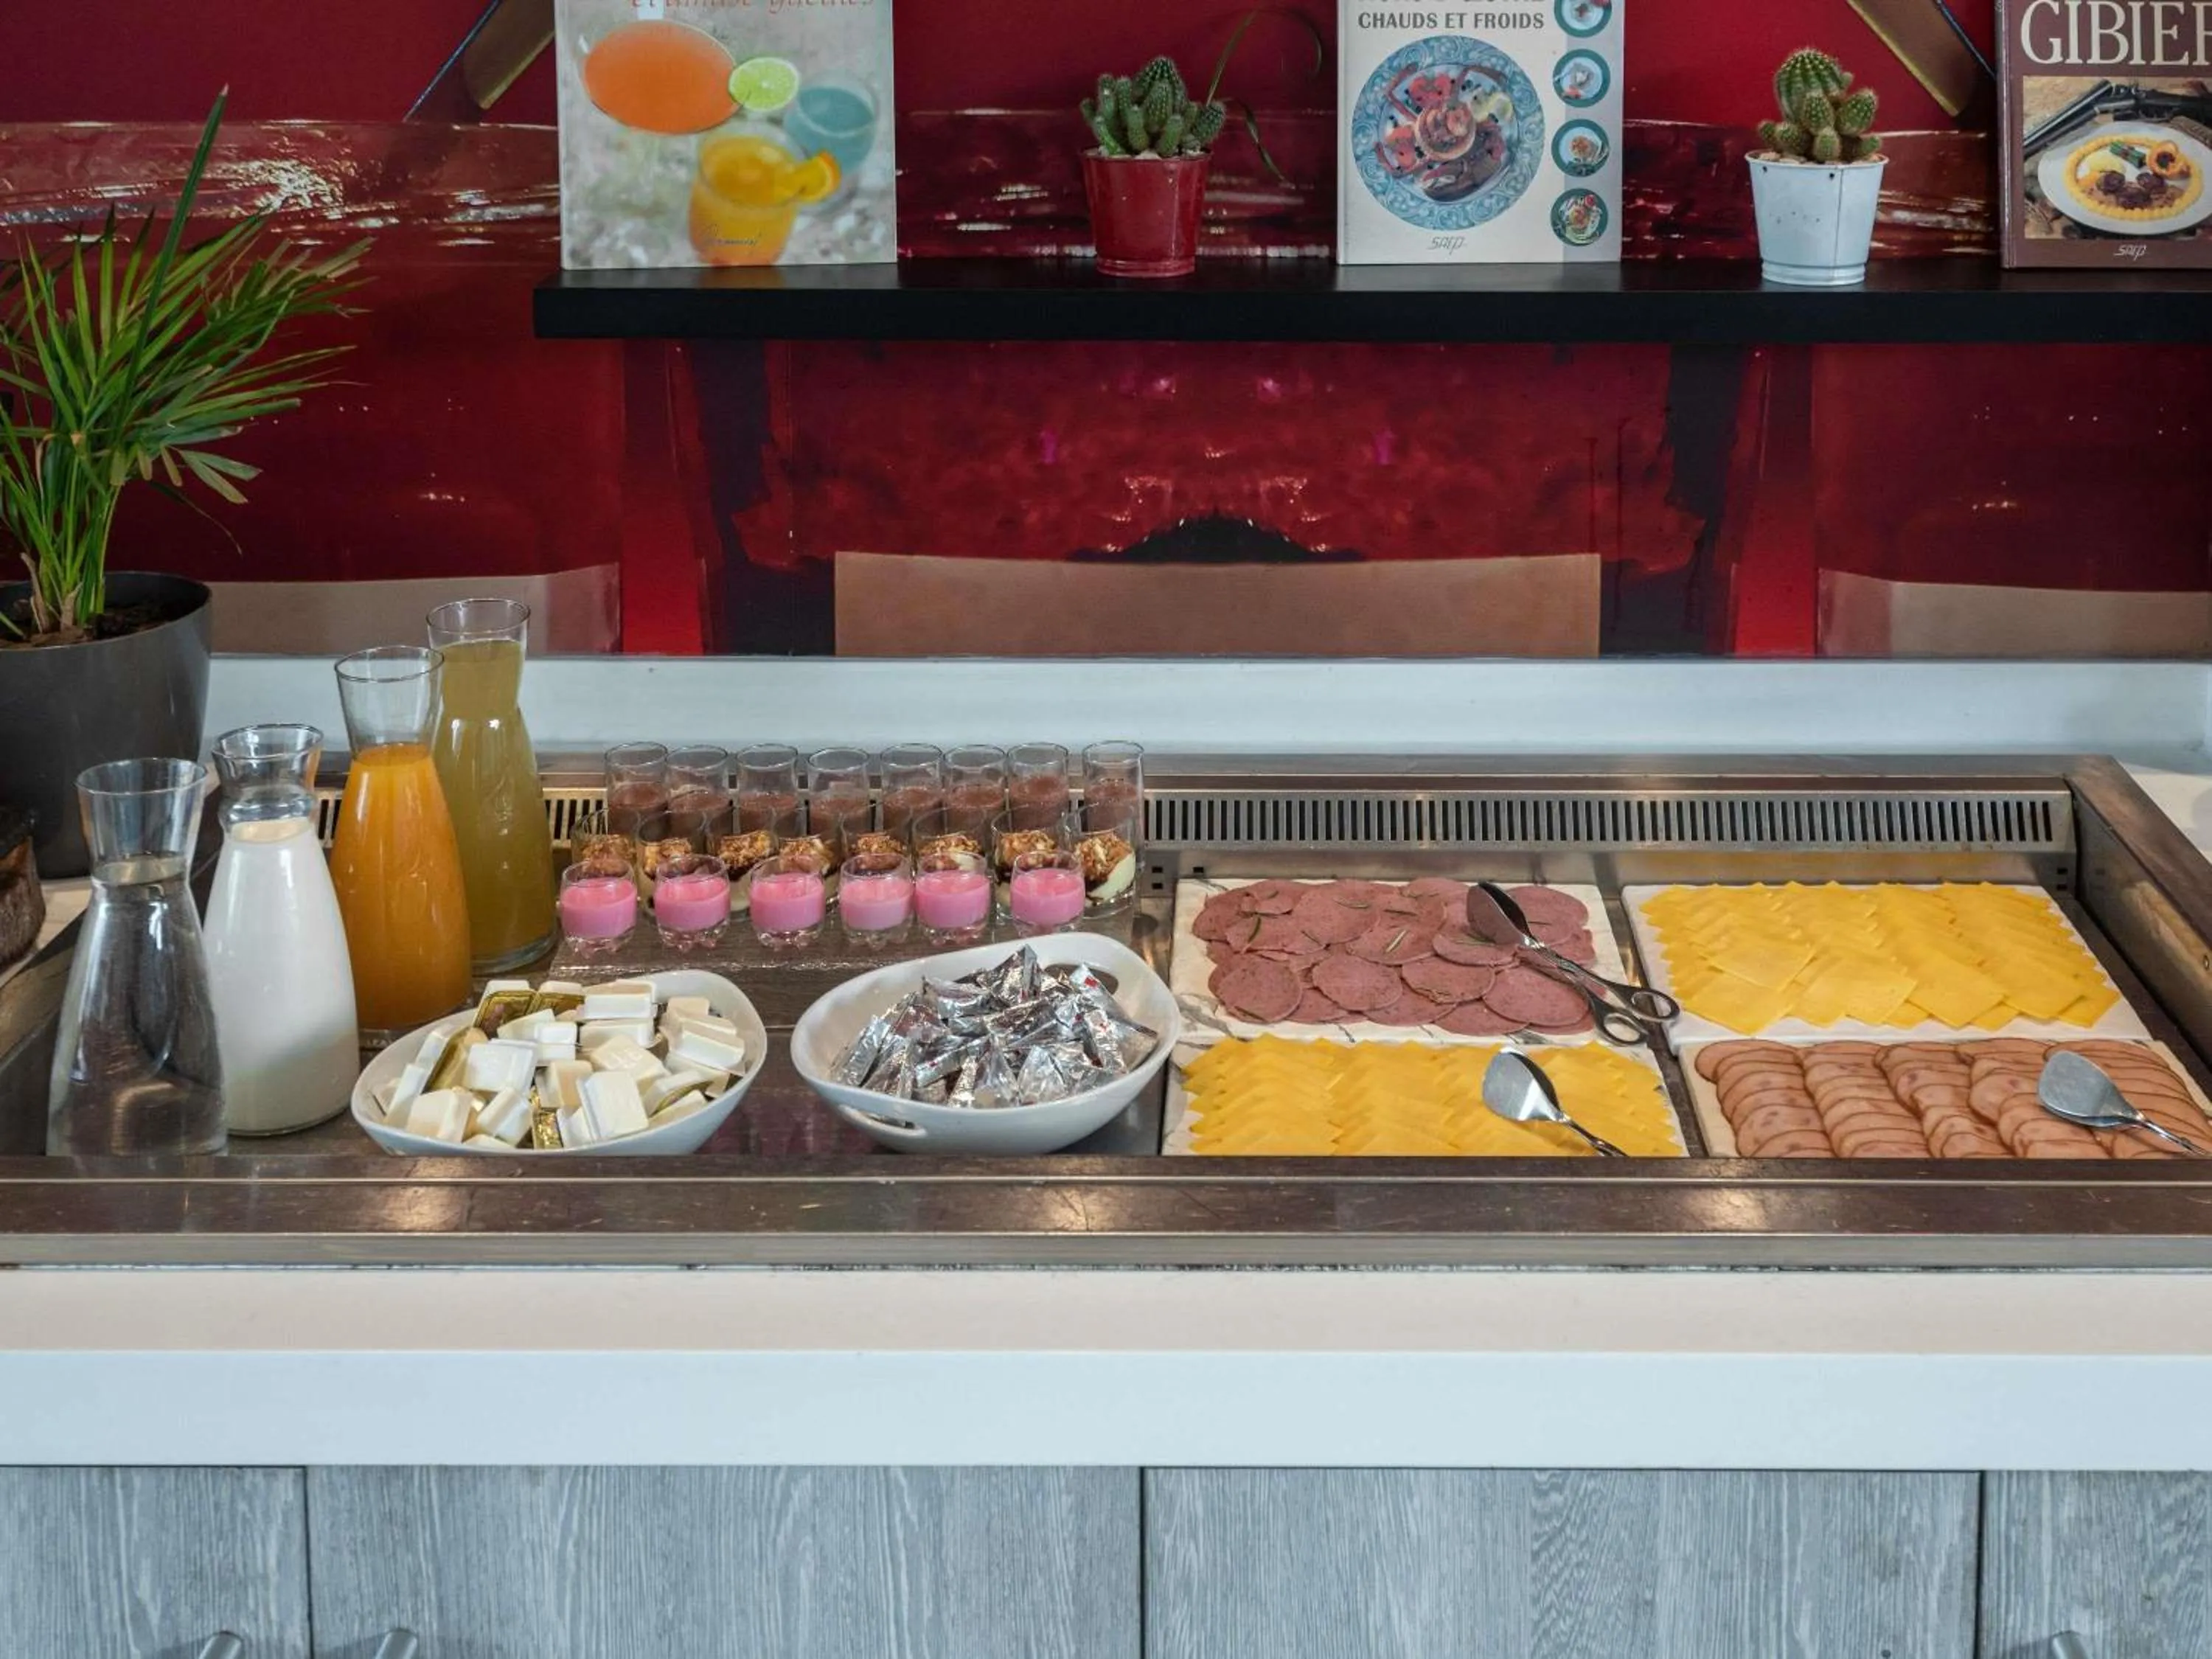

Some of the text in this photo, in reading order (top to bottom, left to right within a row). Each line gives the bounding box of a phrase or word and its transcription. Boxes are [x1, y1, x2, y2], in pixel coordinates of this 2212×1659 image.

[1357, 12, 1545, 29] CHAUDS ET FROIDS
